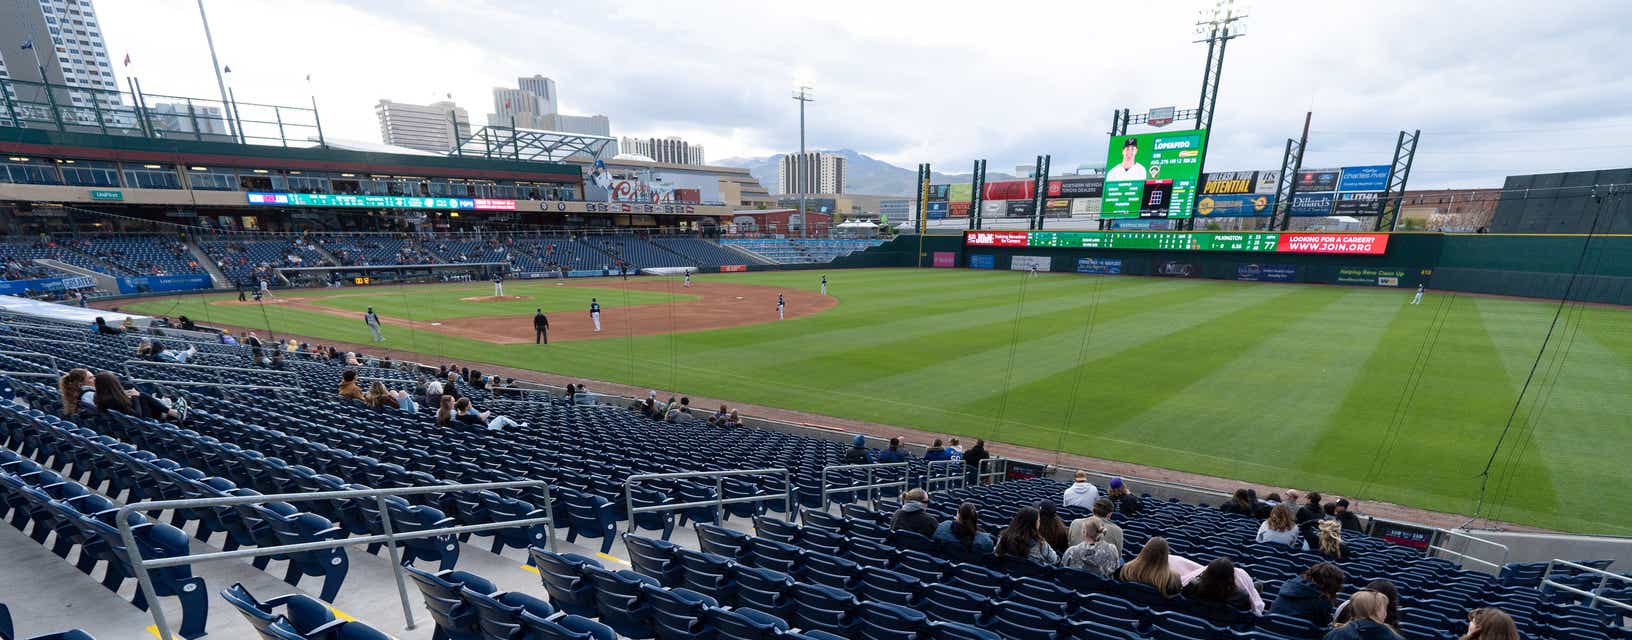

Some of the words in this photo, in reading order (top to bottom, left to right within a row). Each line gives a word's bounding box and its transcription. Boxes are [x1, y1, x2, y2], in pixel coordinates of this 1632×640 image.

[1203, 179, 1250, 194] POTENTIAL
[1351, 193, 1378, 202] LITHIA
[1292, 197, 1330, 208] Dillard's
[1264, 241, 1276, 250] 77
[1290, 243, 1372, 252] WWW.JOIN.ORG
[1340, 269, 1362, 277] Helping
